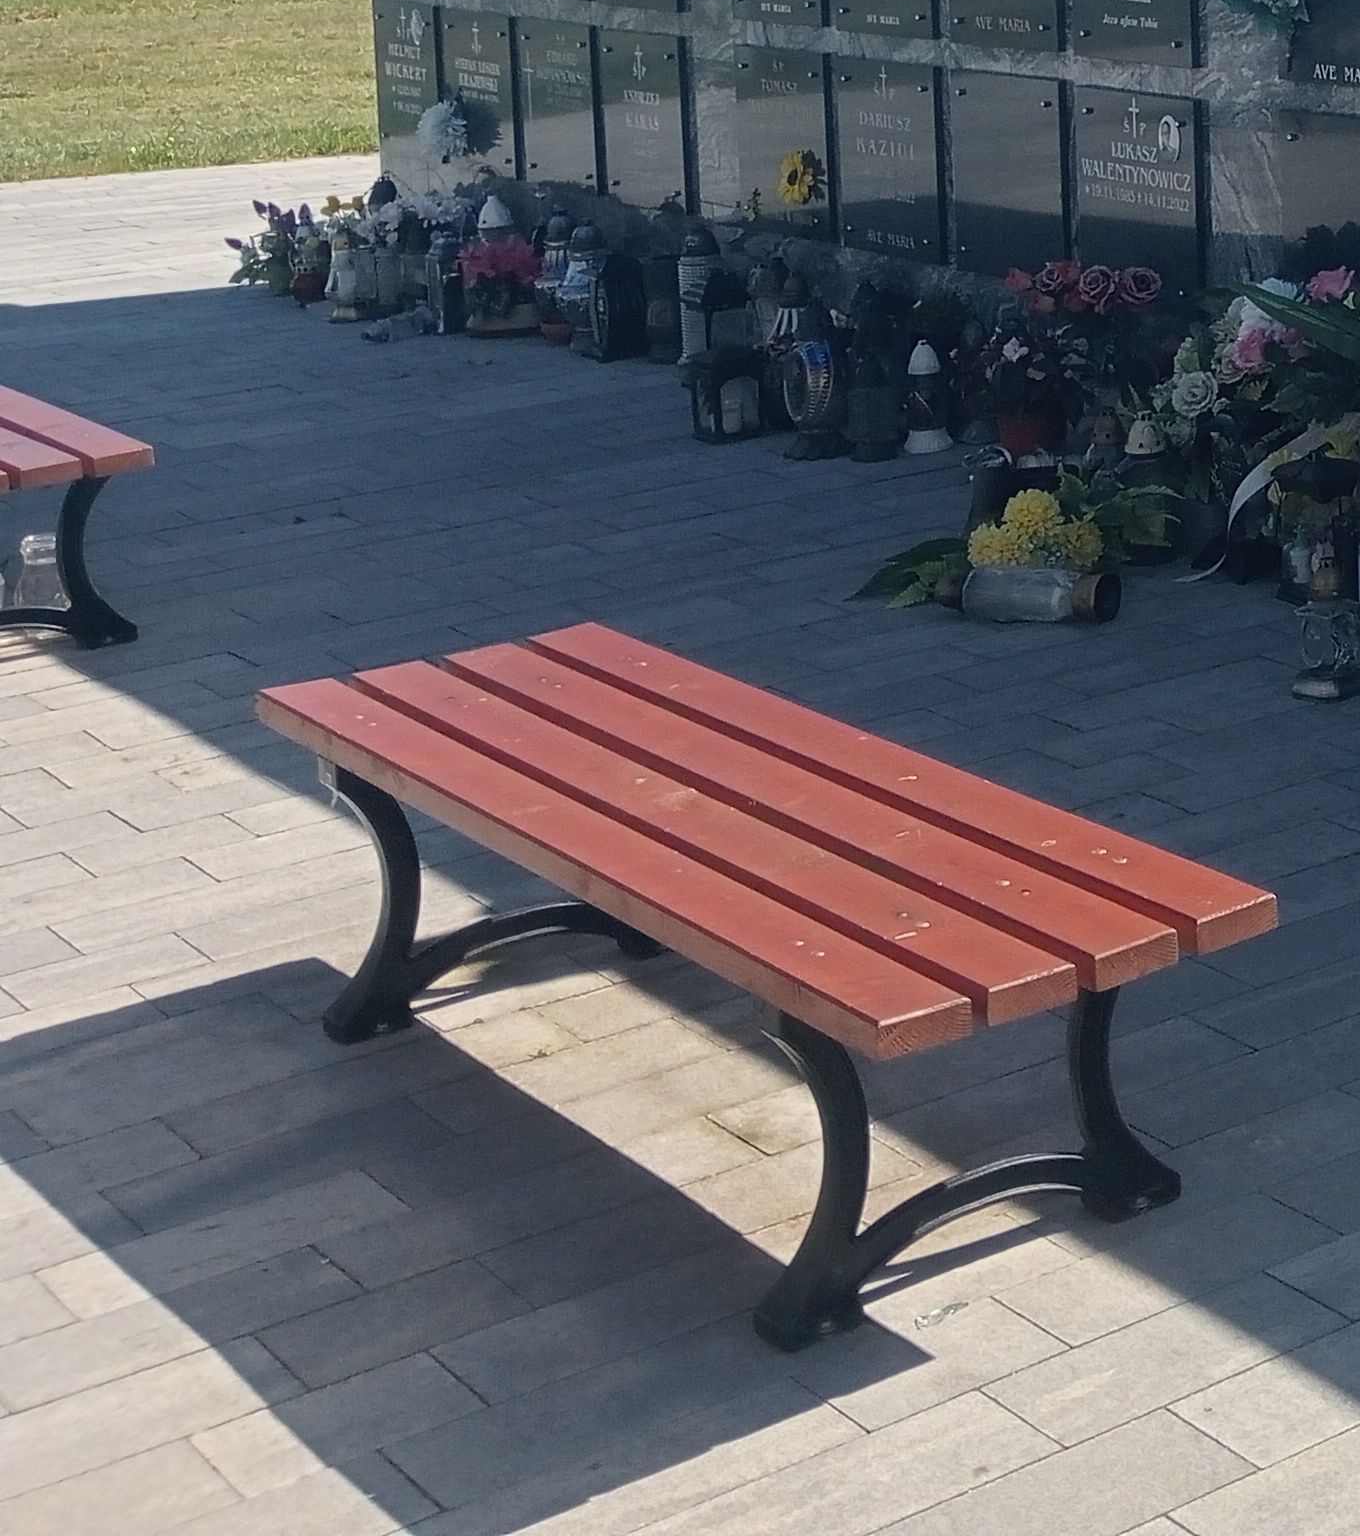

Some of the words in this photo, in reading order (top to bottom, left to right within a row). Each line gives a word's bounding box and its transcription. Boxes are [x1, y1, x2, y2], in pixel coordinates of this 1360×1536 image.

[999, 17, 1030, 32] MARIA
[1313, 63, 1337, 80] AVE
[859, 110, 911, 132] DARIUSZ
[1081, 158, 1191, 192] WALENTYNOWICZ
